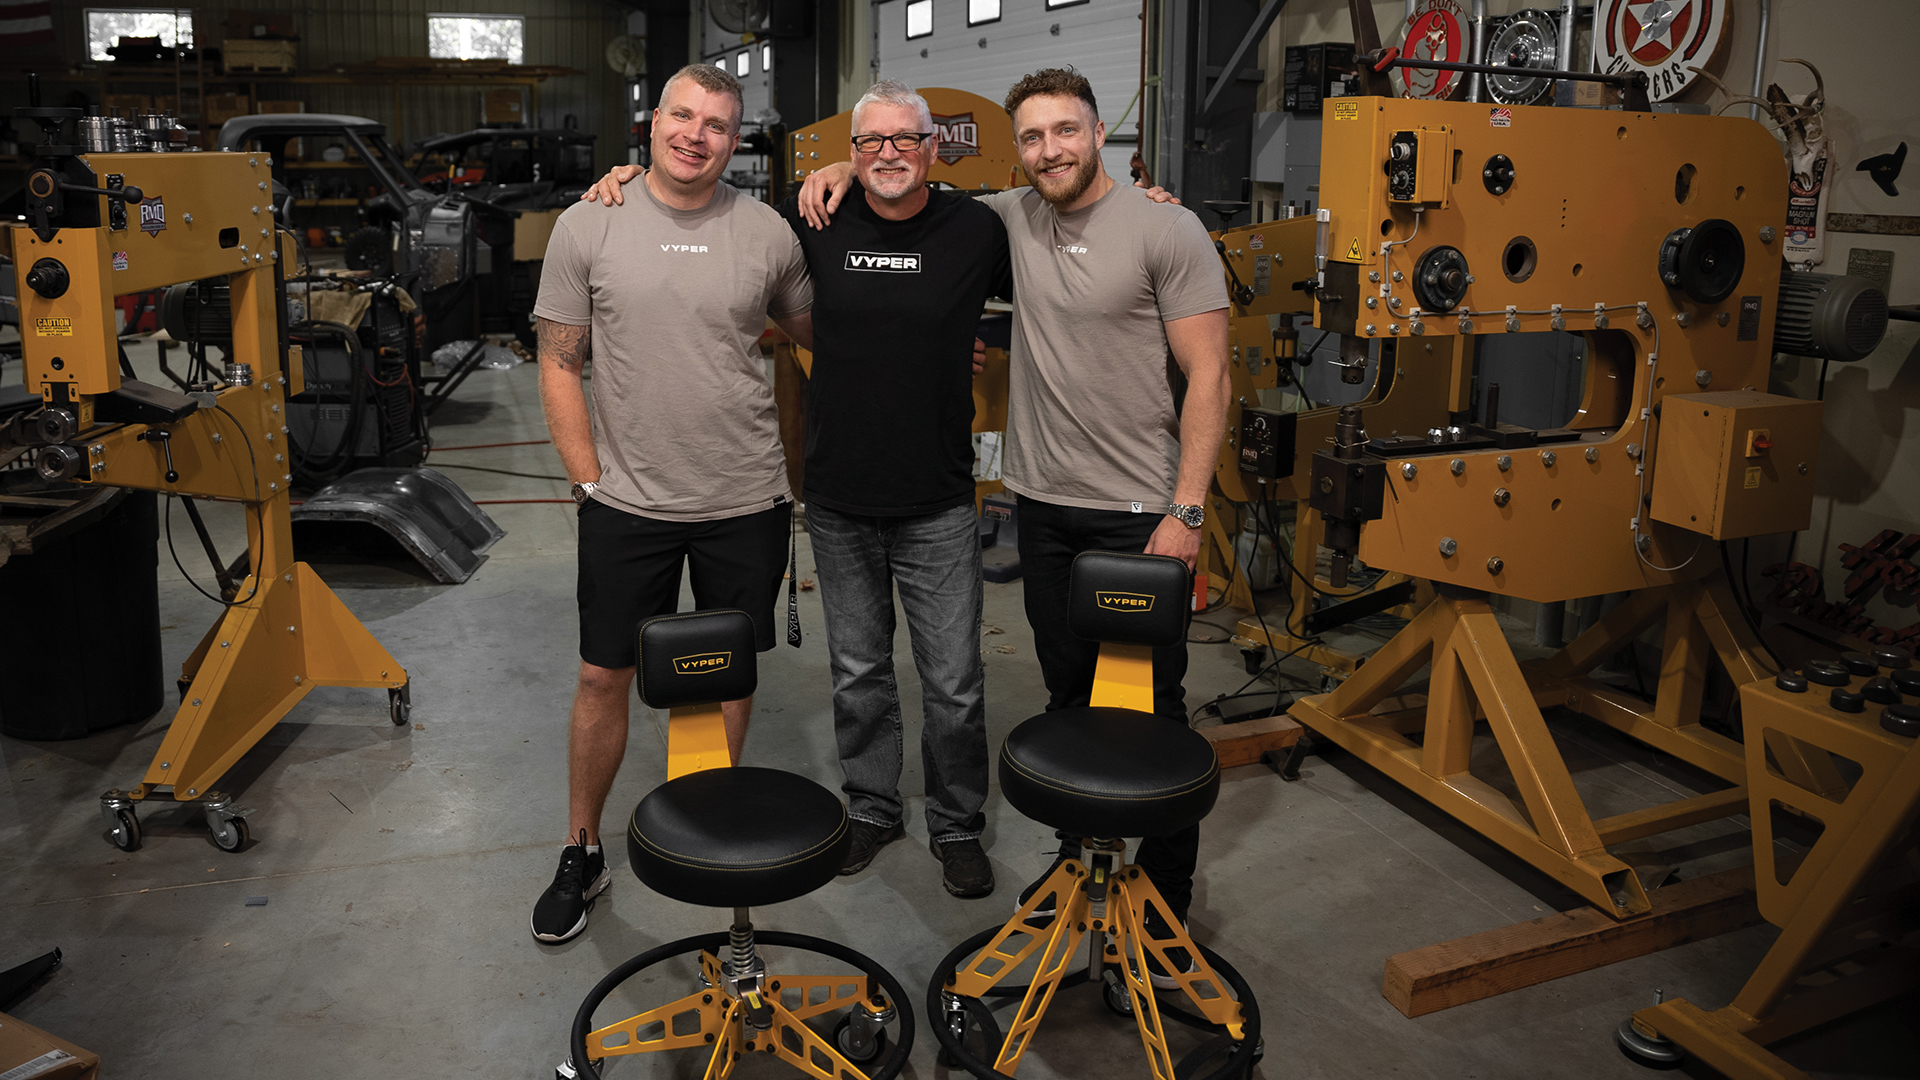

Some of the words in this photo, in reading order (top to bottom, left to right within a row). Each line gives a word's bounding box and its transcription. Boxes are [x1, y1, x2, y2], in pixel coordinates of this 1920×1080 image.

[1407, 6, 1424, 26] WE
[1788, 209, 1816, 219] MAGNUM
[1792, 217, 1811, 226] SHOT
[660, 244, 708, 253] VYPER
[850, 255, 918, 269] VYPER
[37, 318, 70, 327] CAUTION
[1104, 597, 1147, 607] VYPER
[789, 594, 798, 642] VYPER
[681, 658, 724, 669] VYPER
